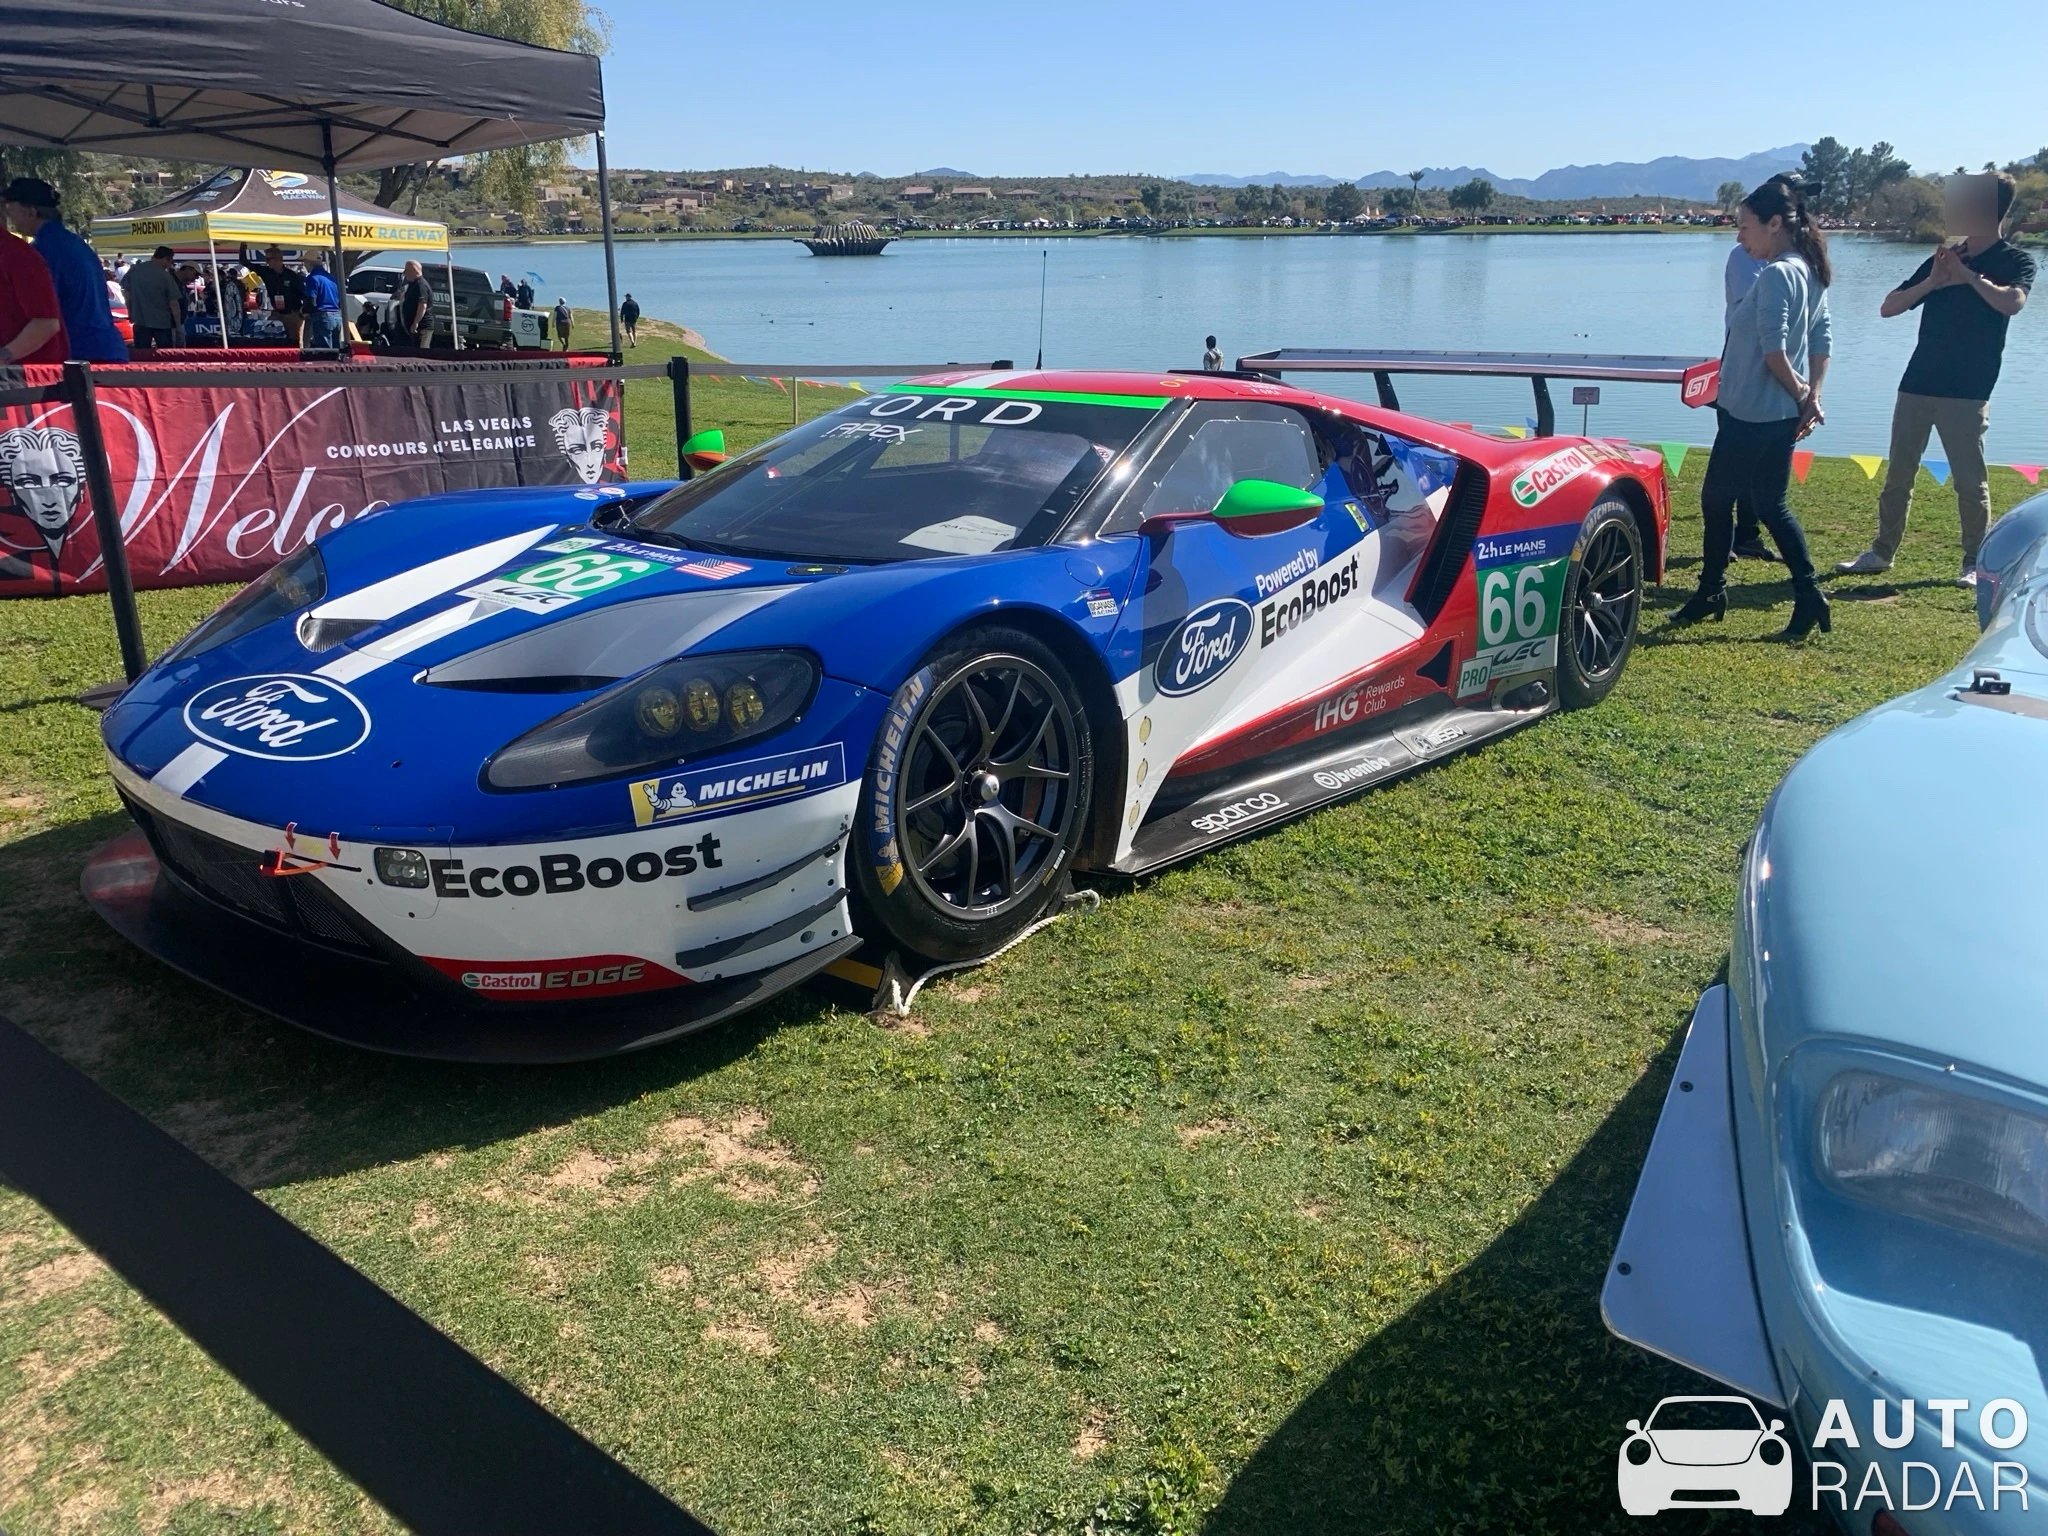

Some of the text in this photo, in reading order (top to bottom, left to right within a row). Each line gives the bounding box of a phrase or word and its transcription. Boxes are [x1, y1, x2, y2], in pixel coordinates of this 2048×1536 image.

[273, 188, 318, 197] PHOENIX
[282, 193, 326, 201] RACEWAY
[131, 217, 206, 236] PHOENIX RACEWAY
[305, 222, 446, 242] PHOENIX RACEWAY
[836, 394, 1044, 425] FORD
[441, 416, 533, 434] LAS VEGAS
[825, 422, 923, 442] APEX
[326, 440, 428, 460] CONCOURS
[1531, 450, 1588, 494] Castrol
[1585, 501, 1625, 536] MICHELIN
[1500, 544, 1513, 556] LE
[1514, 539, 1546, 554] MANS
[517, 553, 651, 592] 66
[1255, 548, 1320, 598] Powered by
[1091, 608, 1118, 617] RACING
[1260, 554, 1359, 650] EcoBoost
[1482, 565, 1546, 647] 66
[1175, 611, 1237, 685] Ford
[1492, 640, 1547, 667] WEC
[1461, 666, 1488, 690] PRO
[200, 680, 339, 748] Ford
[1314, 675, 1405, 732] IHG Rewards
[1364, 698, 1387, 714] Club
[875, 675, 925, 834] MICHELIN
[699, 759, 829, 802] MICHELIN
[1332, 756, 1391, 784] brembo
[1190, 792, 1282, 832] sparco
[428, 831, 723, 899] EcoBoost
[481, 962, 647, 989] Castrol EDGE
